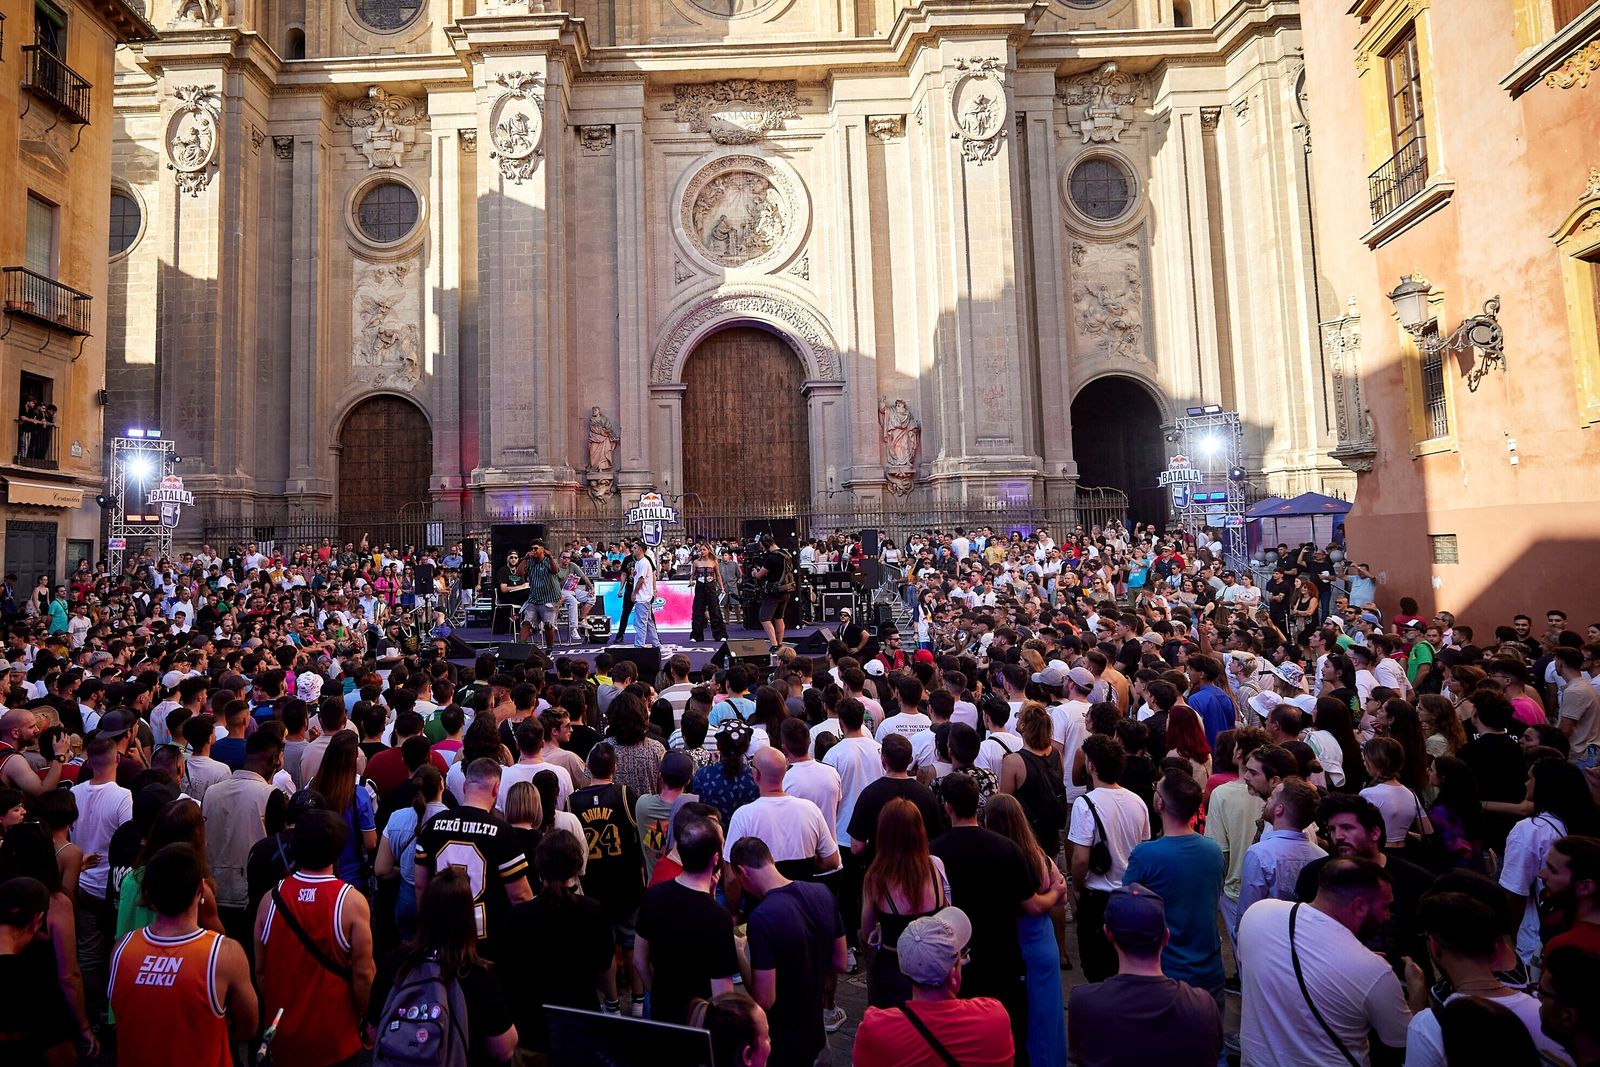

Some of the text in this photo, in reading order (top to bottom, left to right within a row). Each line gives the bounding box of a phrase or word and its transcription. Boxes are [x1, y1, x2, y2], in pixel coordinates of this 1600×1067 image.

[1162, 470, 1199, 483] BATALLA
[152, 490, 190, 502] BATALLA
[632, 508, 671, 521] BATALLA
[582, 807, 613, 823] BRYANT
[462, 821, 498, 836] UNLTD
[583, 824, 622, 860] 24
[297, 887, 318, 902] SFDK
[140, 954, 184, 973] SON
[135, 972, 177, 987] GOKU
